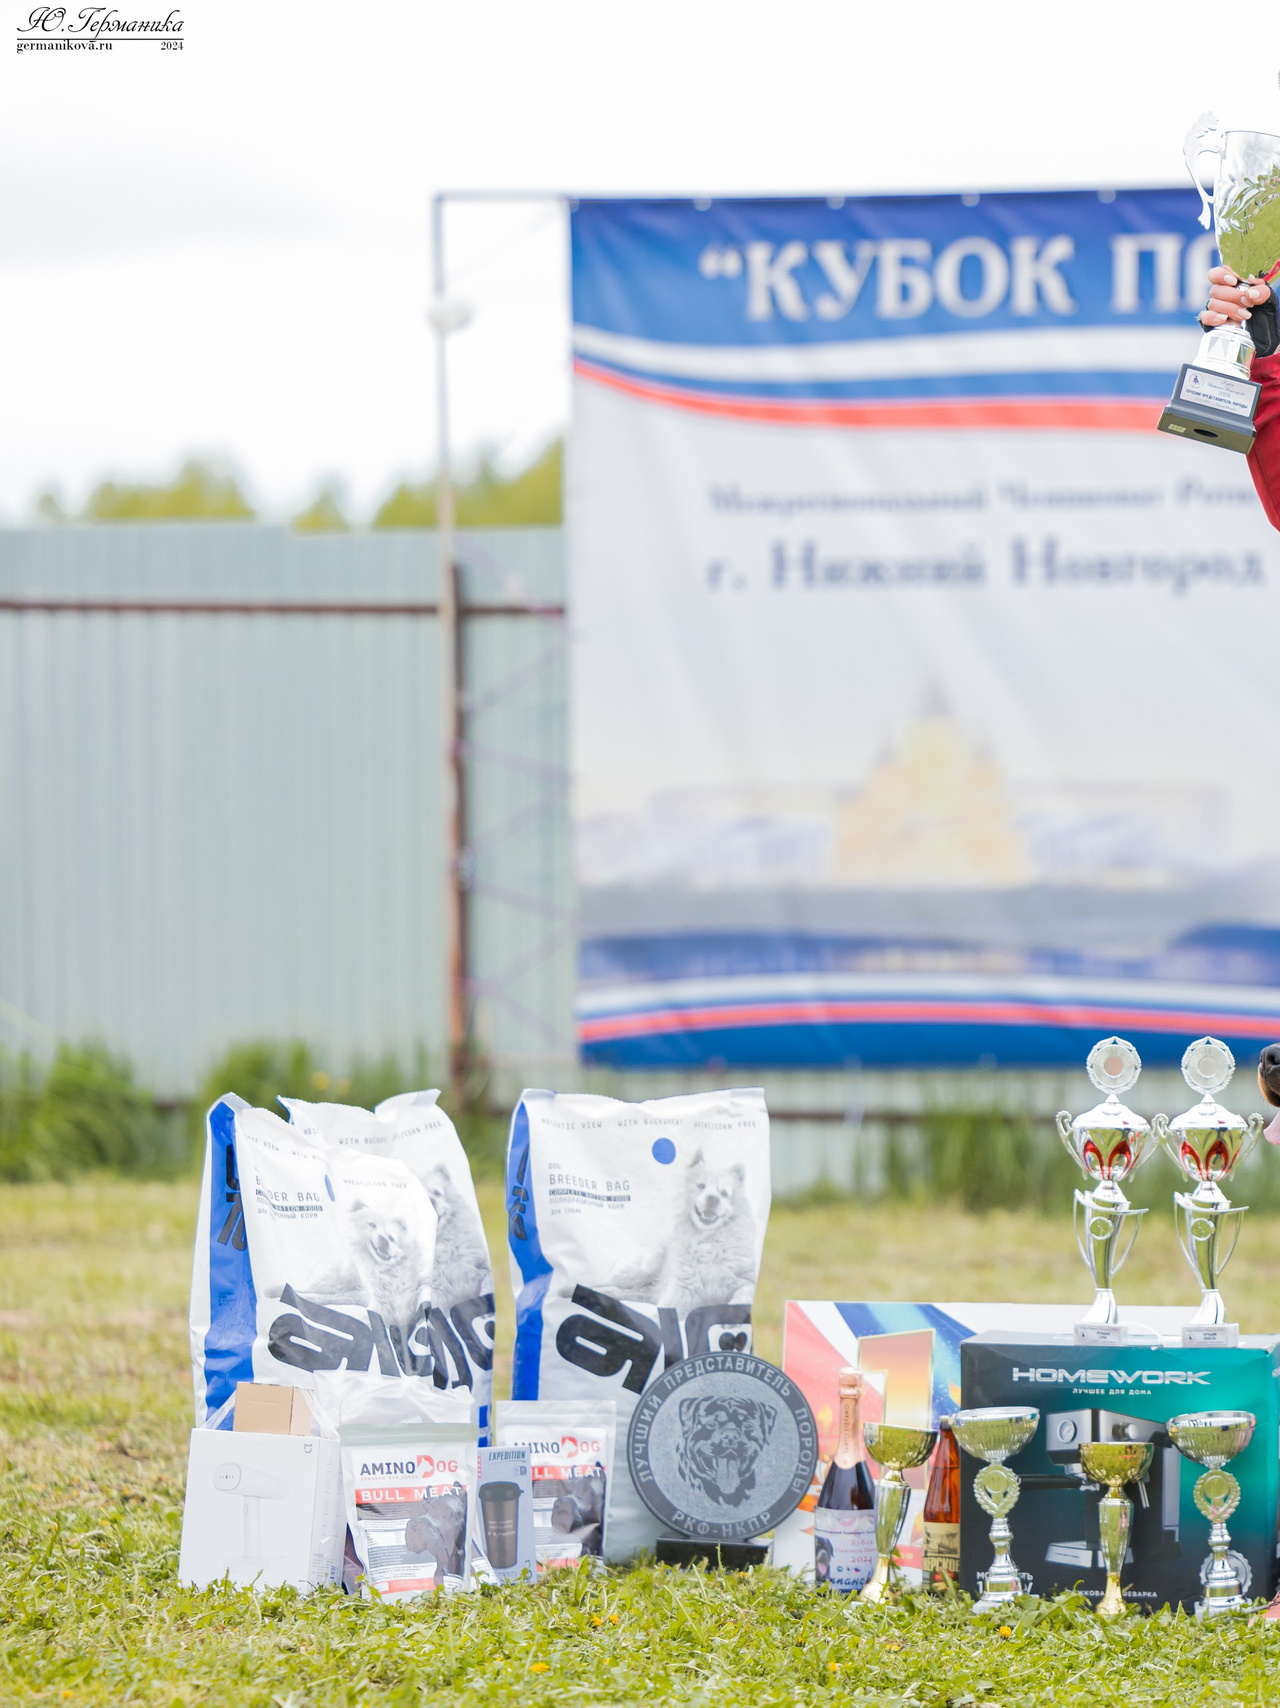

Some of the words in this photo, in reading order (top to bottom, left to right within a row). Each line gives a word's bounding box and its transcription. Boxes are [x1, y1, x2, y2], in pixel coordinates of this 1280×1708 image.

[581, 1121, 602, 1129] VIEW
[618, 1119, 639, 1127] WITH
[549, 1173, 598, 1190] BREEDER
[606, 1180, 630, 1191] BAG
[297, 1191, 321, 1202] BAG
[1012, 1367, 1211, 1385] HOMEWORK
[1072, 1387, 1105, 1395] ЛУЧШЕЕ
[1109, 1388, 1126, 1396] ДЛЯ
[1129, 1388, 1152, 1396] ДОМА
[634, 1394, 662, 1483] ЛУЧШИЙ
[664, 1356, 791, 1396] ПРЕДСТАВИТЕЛЬ
[790, 1406, 813, 1494] ПОРОДЫ
[488, 1450, 526, 1461] EXPEDITION
[560, 1466, 602, 1478] MEAT
[361, 1489, 405, 1502] BULL
[413, 1486, 462, 1499] MEAT
